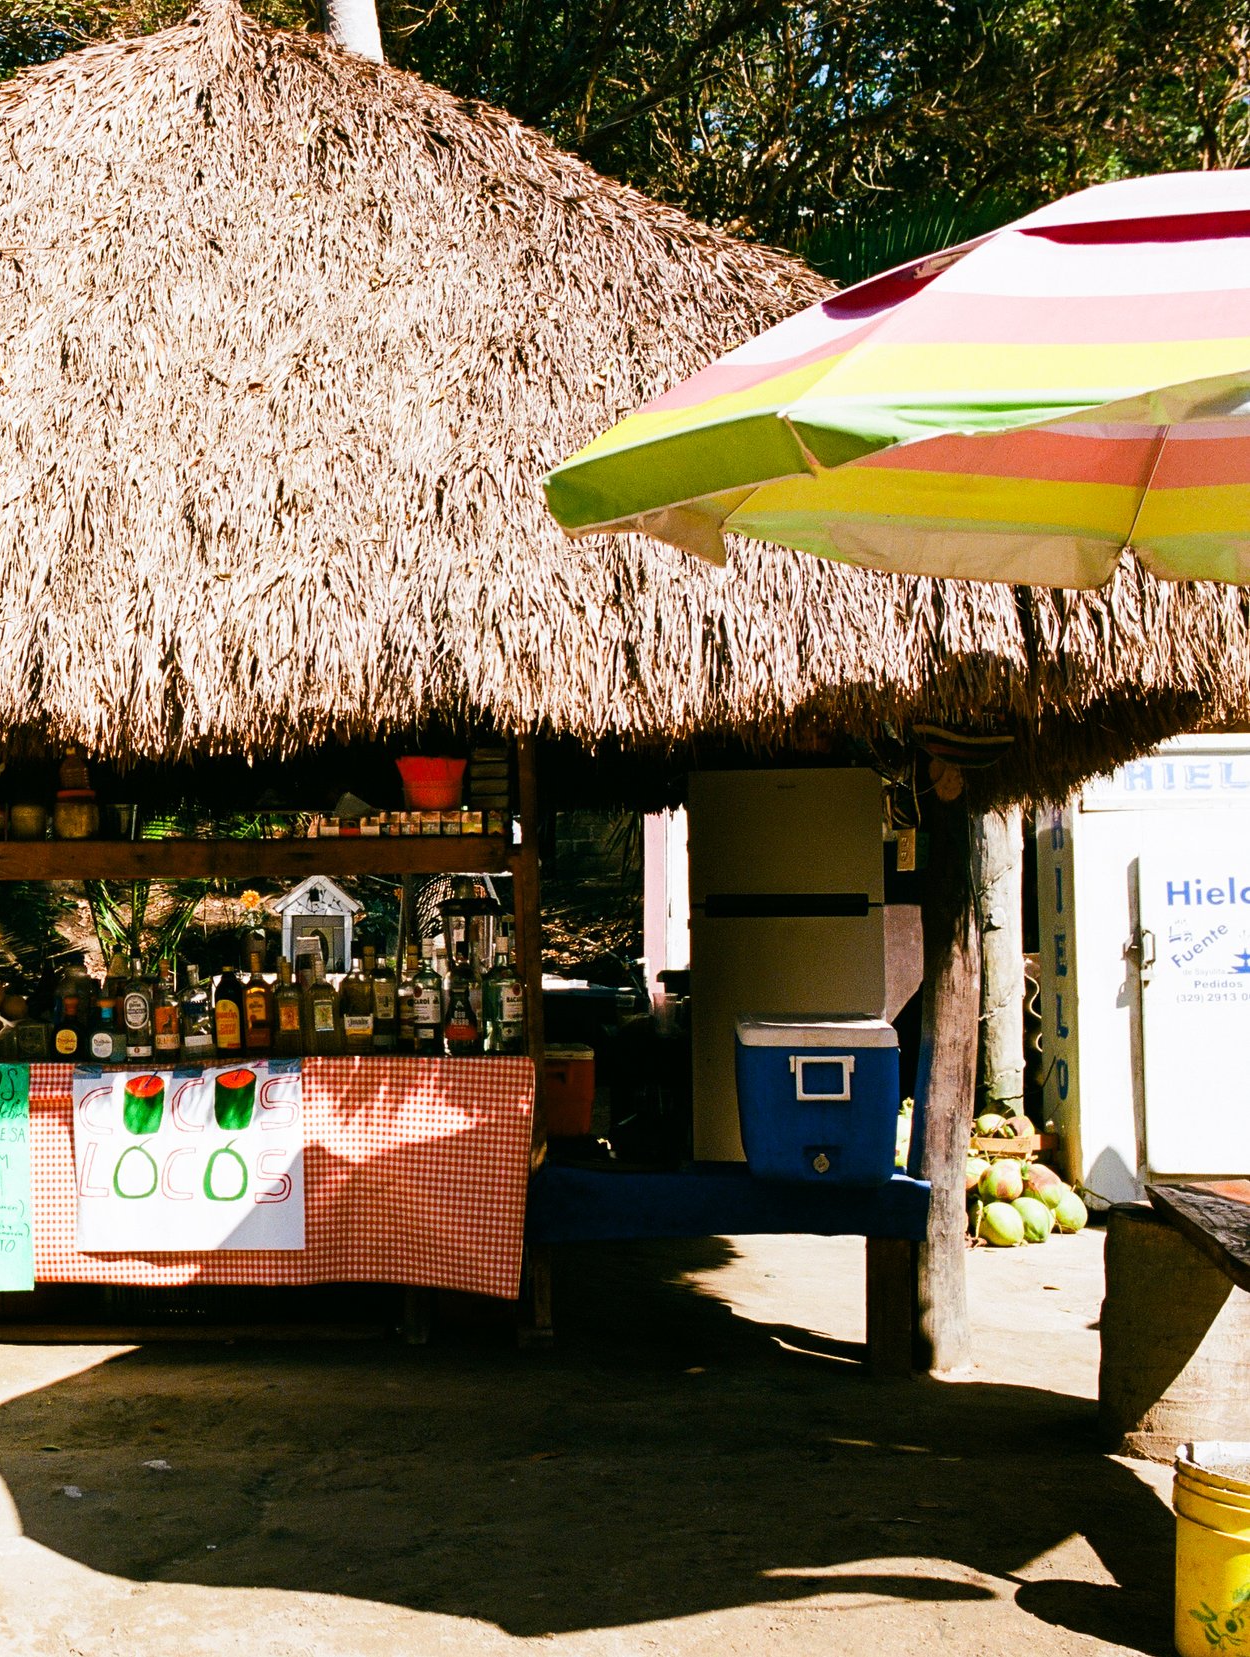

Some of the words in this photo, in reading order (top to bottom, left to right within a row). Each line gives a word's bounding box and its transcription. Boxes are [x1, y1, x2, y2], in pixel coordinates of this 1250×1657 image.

[1171, 924, 1228, 968] Fuente
[1194, 980, 1243, 989] Pedidos
[1176, 994, 1204, 1004] (329)
[1207, 993, 1237, 1002] 2913
